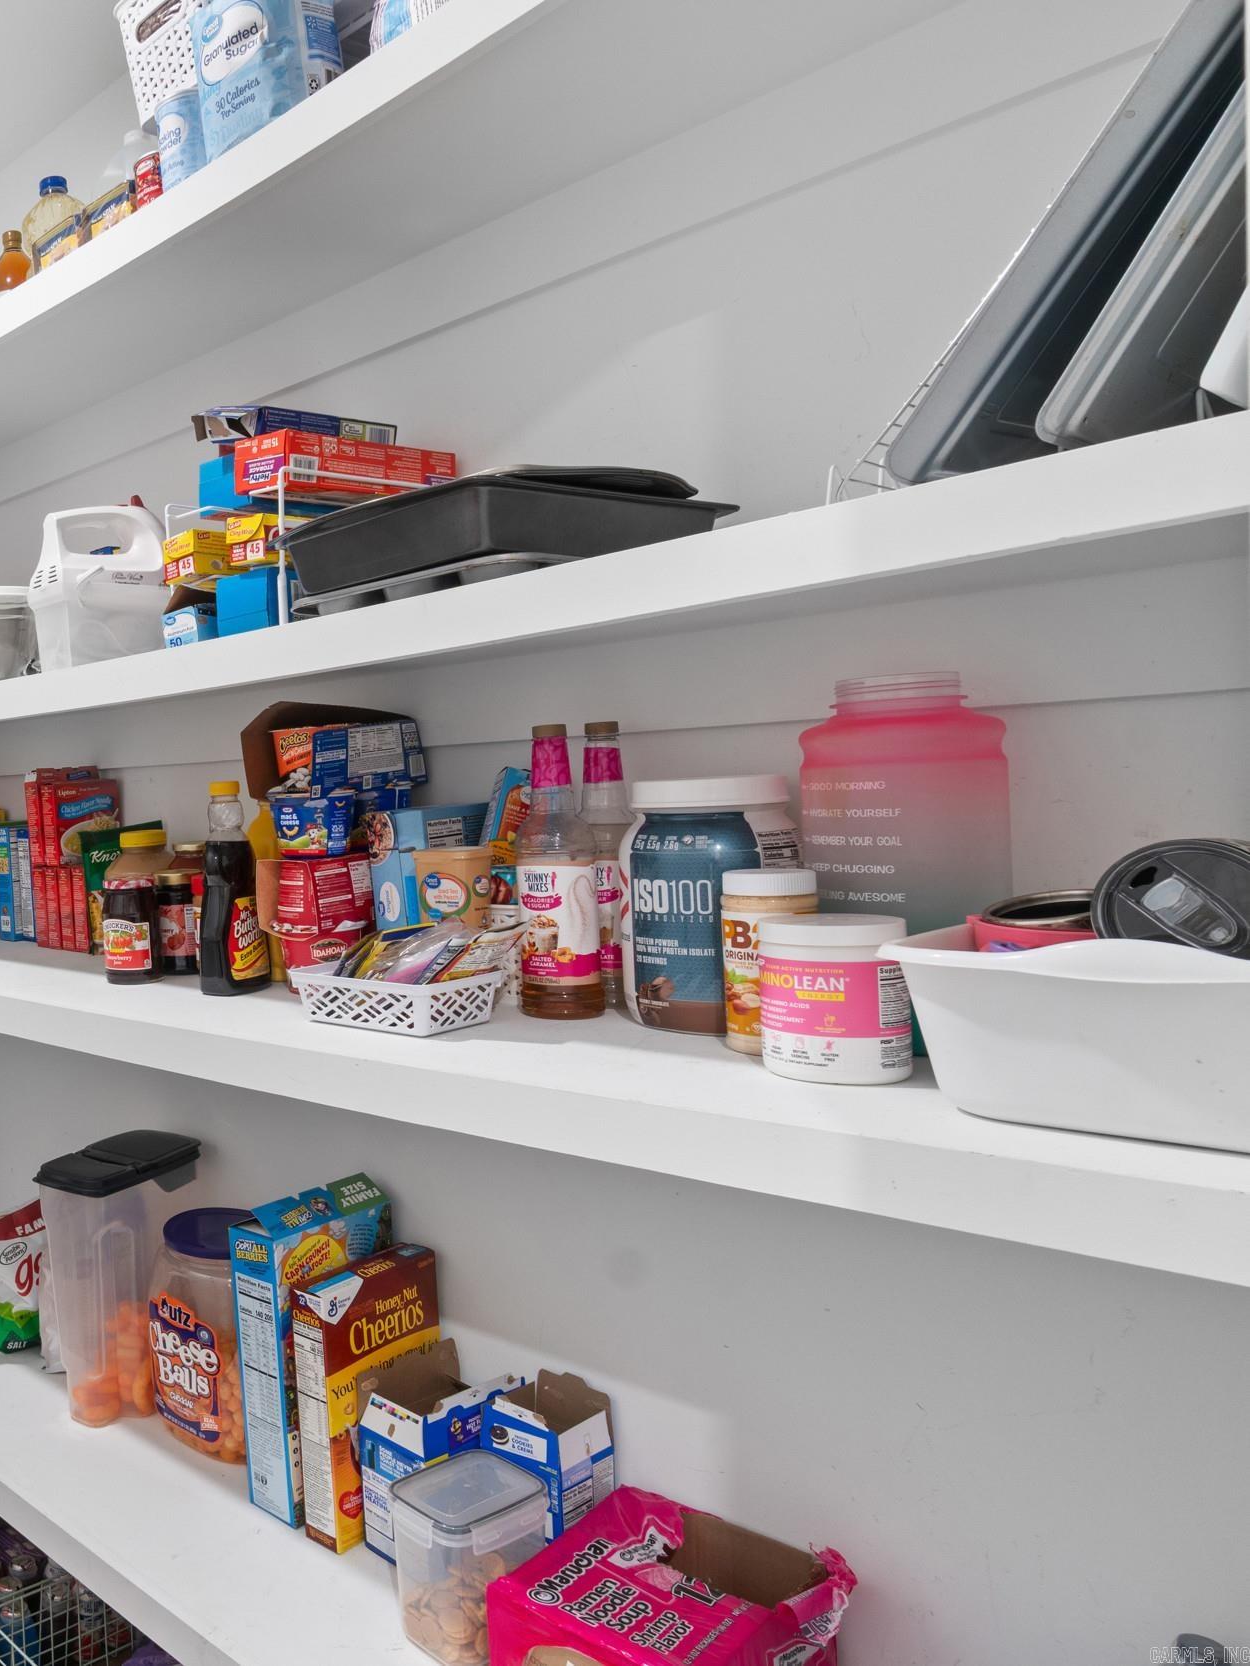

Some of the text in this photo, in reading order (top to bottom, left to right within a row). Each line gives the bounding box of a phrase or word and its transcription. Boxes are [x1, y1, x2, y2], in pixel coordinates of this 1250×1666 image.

[203, 22, 259, 66] Granulated
[225, 37, 261, 62] Sugar
[225, 77, 261, 104] Calories
[159, 127, 181, 147] aking
[250, 471, 270, 484] Hefty
[249, 542, 260, 554] 45
[181, 559, 192, 571] 45
[170, 637, 182, 648] 50
[280, 733, 310, 754] Cheetos
[809, 780, 886, 791] GOOD MORNING
[810, 808, 902, 818] HYDRATE YOURSELF
[848, 836, 873, 846] YOUR
[876, 836, 903, 846] GOAL
[90, 850, 120, 863] Kno
[832, 864, 895, 874] CHUGGING
[524, 872, 549, 883] SKINNY
[527, 883, 549, 892] MIXES
[633, 878, 713, 915] ISO100
[848, 891, 907, 903] AWESOME
[634, 913, 715, 923] HYDROLYZED
[655, 938, 679, 947] POWDER
[313, 946, 347, 958] IDAHOAN
[647, 946, 661, 954] WHEY
[663, 947, 687, 956] PROTEIN
[689, 948, 716, 956] ISOLATE
[725, 950, 759, 963] ORIGINA
[643, 956, 668, 965] SERVINGS
[760, 970, 845, 991] MINOLEAN
[790, 1001, 810, 1009] ACIDS
[340, 1180, 367, 1196] SIZE
[340, 1186, 382, 1208] FAMILY
[15, 1217, 45, 1236] FAM
[252, 1243, 268, 1254] ALL
[236, 1251, 269, 1263] BERRIES
[285, 1261, 305, 1281] CAP'N
[305, 1239, 330, 1268] CRUNCH
[358, 1260, 396, 1278] Cheerios
[257, 1282, 271, 1292] Facts
[375, 1284, 418, 1315] Honey Nut
[255, 1309, 264, 1319] 140
[264, 1313, 273, 1322] 200
[293, 1310, 320, 1327] Cheerios
[350, 1301, 424, 1355] Cheerios
[6, 1340, 27, 1350] SALT
[150, 1321, 220, 1376] Cheese
[158, 1353, 211, 1398] Balls
[332, 1376, 357, 1400] You'
[511, 1437, 533, 1449] COOKIES
[517, 1445, 534, 1455] CREME
[537, 1538, 616, 1595] Maruchan
[559, 1578, 619, 1617] Ramen
[580, 1585, 638, 1627] Noodle
[606, 1600, 652, 1633] Soup
[629, 1610, 679, 1648] Shrimp
[650, 1620, 694, 1656] Flavor
